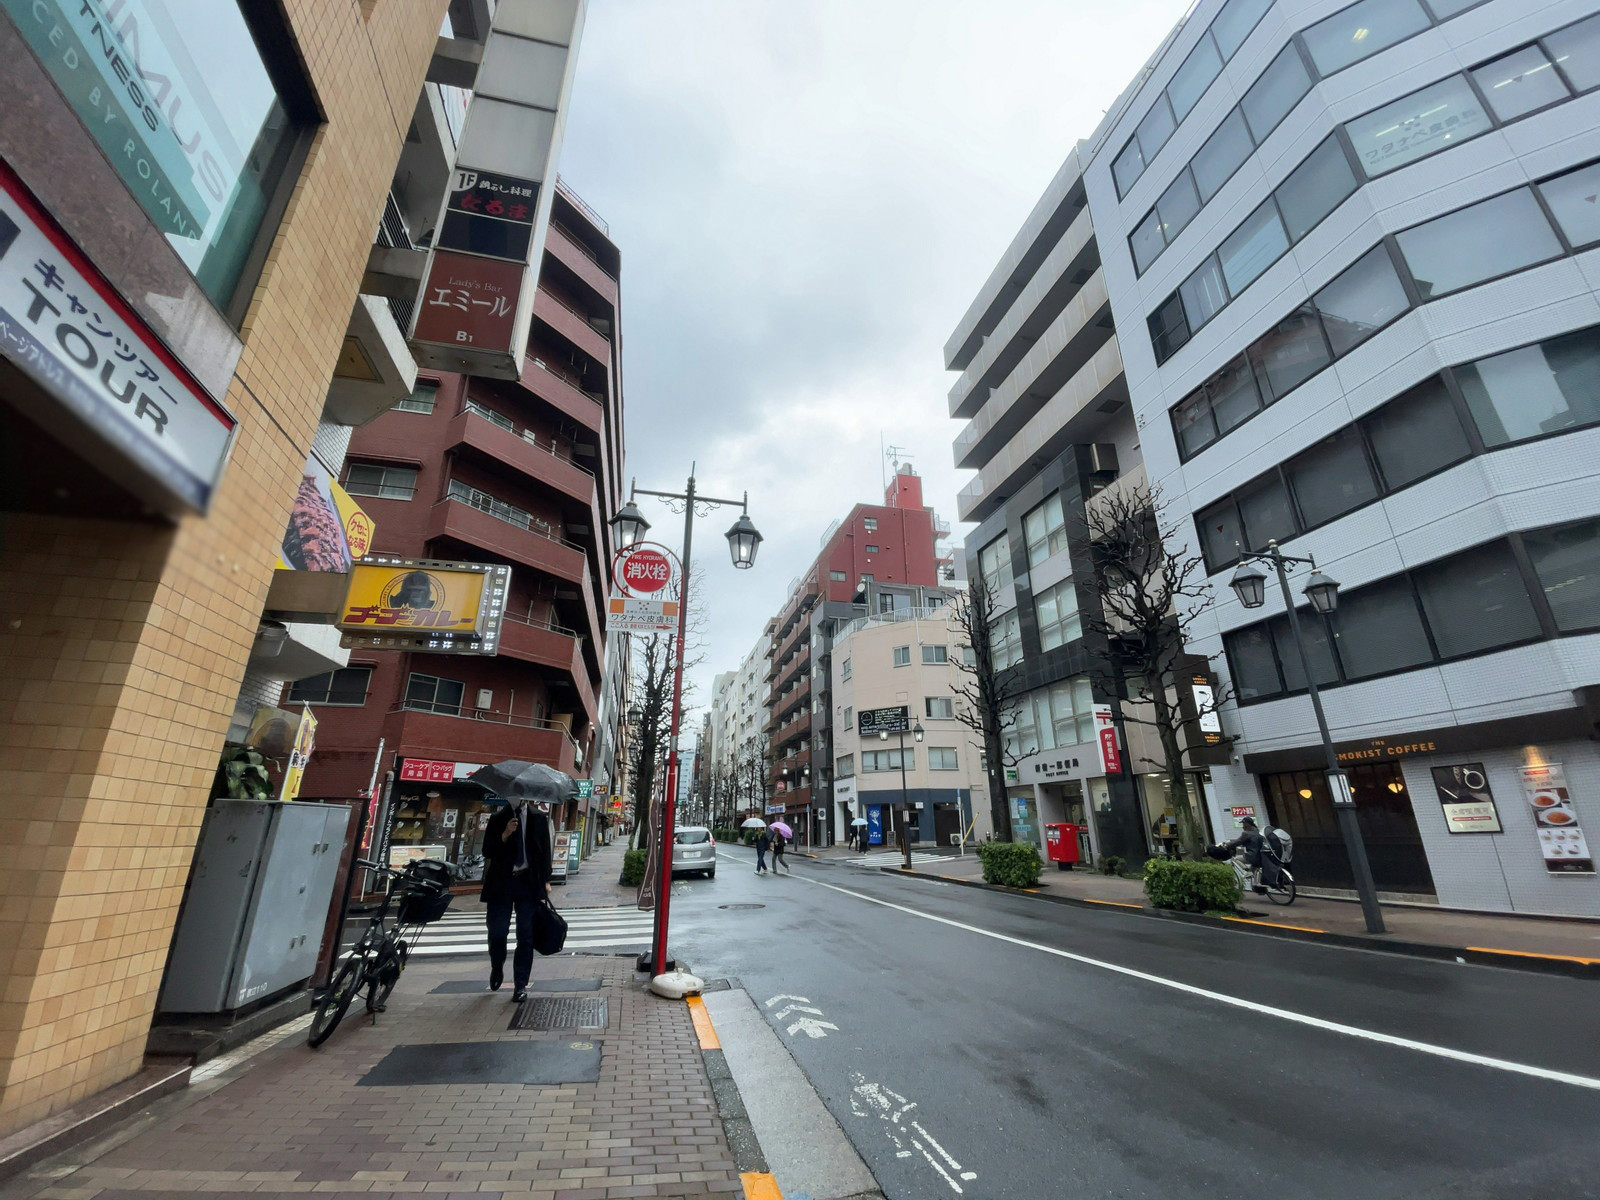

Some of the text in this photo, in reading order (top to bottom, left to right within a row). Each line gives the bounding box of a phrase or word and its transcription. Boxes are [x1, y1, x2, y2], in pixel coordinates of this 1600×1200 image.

[89, 86, 117, 124] BY
[123, 138, 199, 247] ROLAND
[459, 173, 475, 189] 1F
[448, 276, 503, 293] Lady's Bar
[429, 287, 512, 318] エミール
[34, 258, 178, 404] キャンツアー
[456, 329, 474, 344] B1
[21, 277, 170, 438] TOUR
[626, 562, 668, 580] 消火栓
[343, 603, 475, 627] ゴーゴーカレー
[611, 613, 674, 624] ワタナベ皮膚科
[1335, 742, 1437, 761] MOKIST COFFEE
